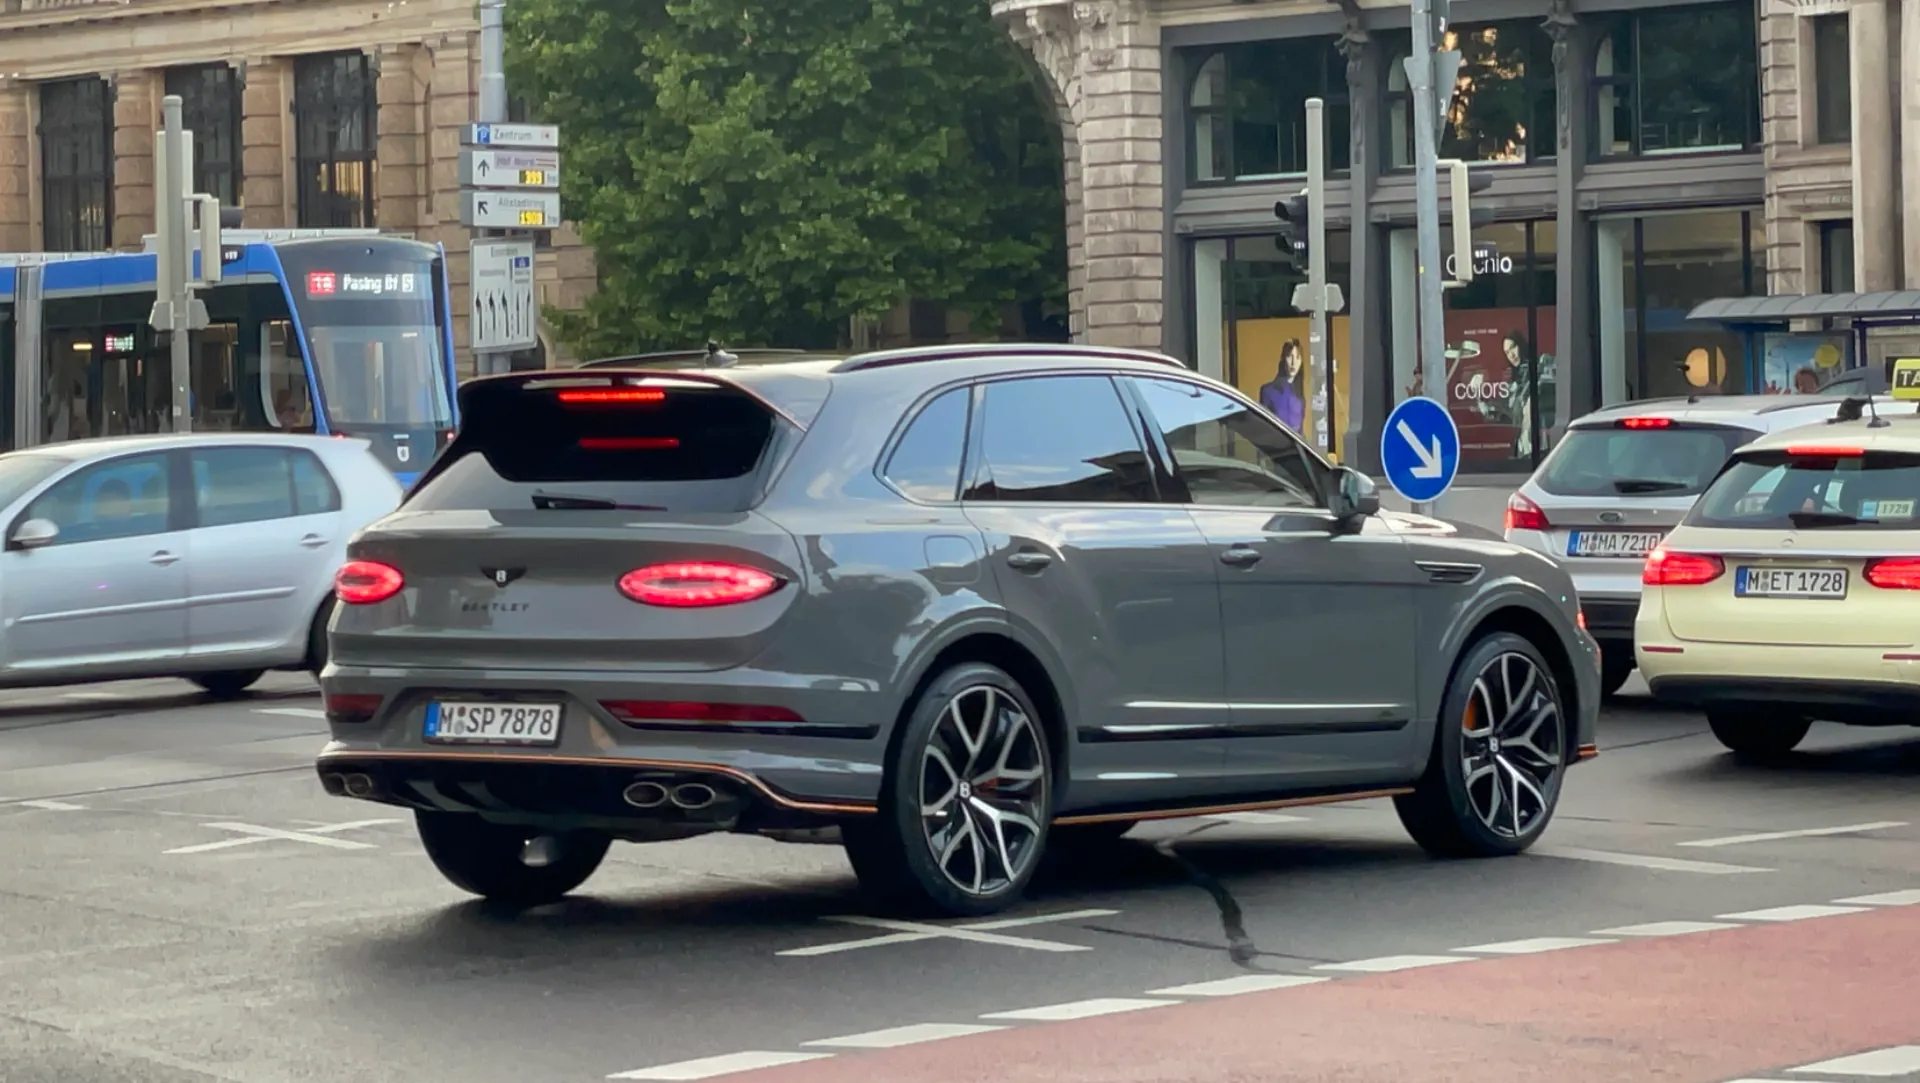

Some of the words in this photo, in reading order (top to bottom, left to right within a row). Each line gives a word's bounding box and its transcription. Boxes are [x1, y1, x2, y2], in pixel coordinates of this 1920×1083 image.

[494, 127, 532, 141] Zentrum
[343, 273, 383, 294] Pasing
[1455, 381, 1509, 400] colors
[1597, 533, 1617, 551] MA
[1621, 534, 1659, 551] 7210
[1747, 571, 1760, 591] M
[1770, 571, 1794, 591] ET
[1797, 572, 1843, 592] 1728
[462, 602, 530, 612] BENTLEY
[440, 704, 454, 733] M
[466, 706, 496, 733] SP
[499, 708, 554, 736] 7878
